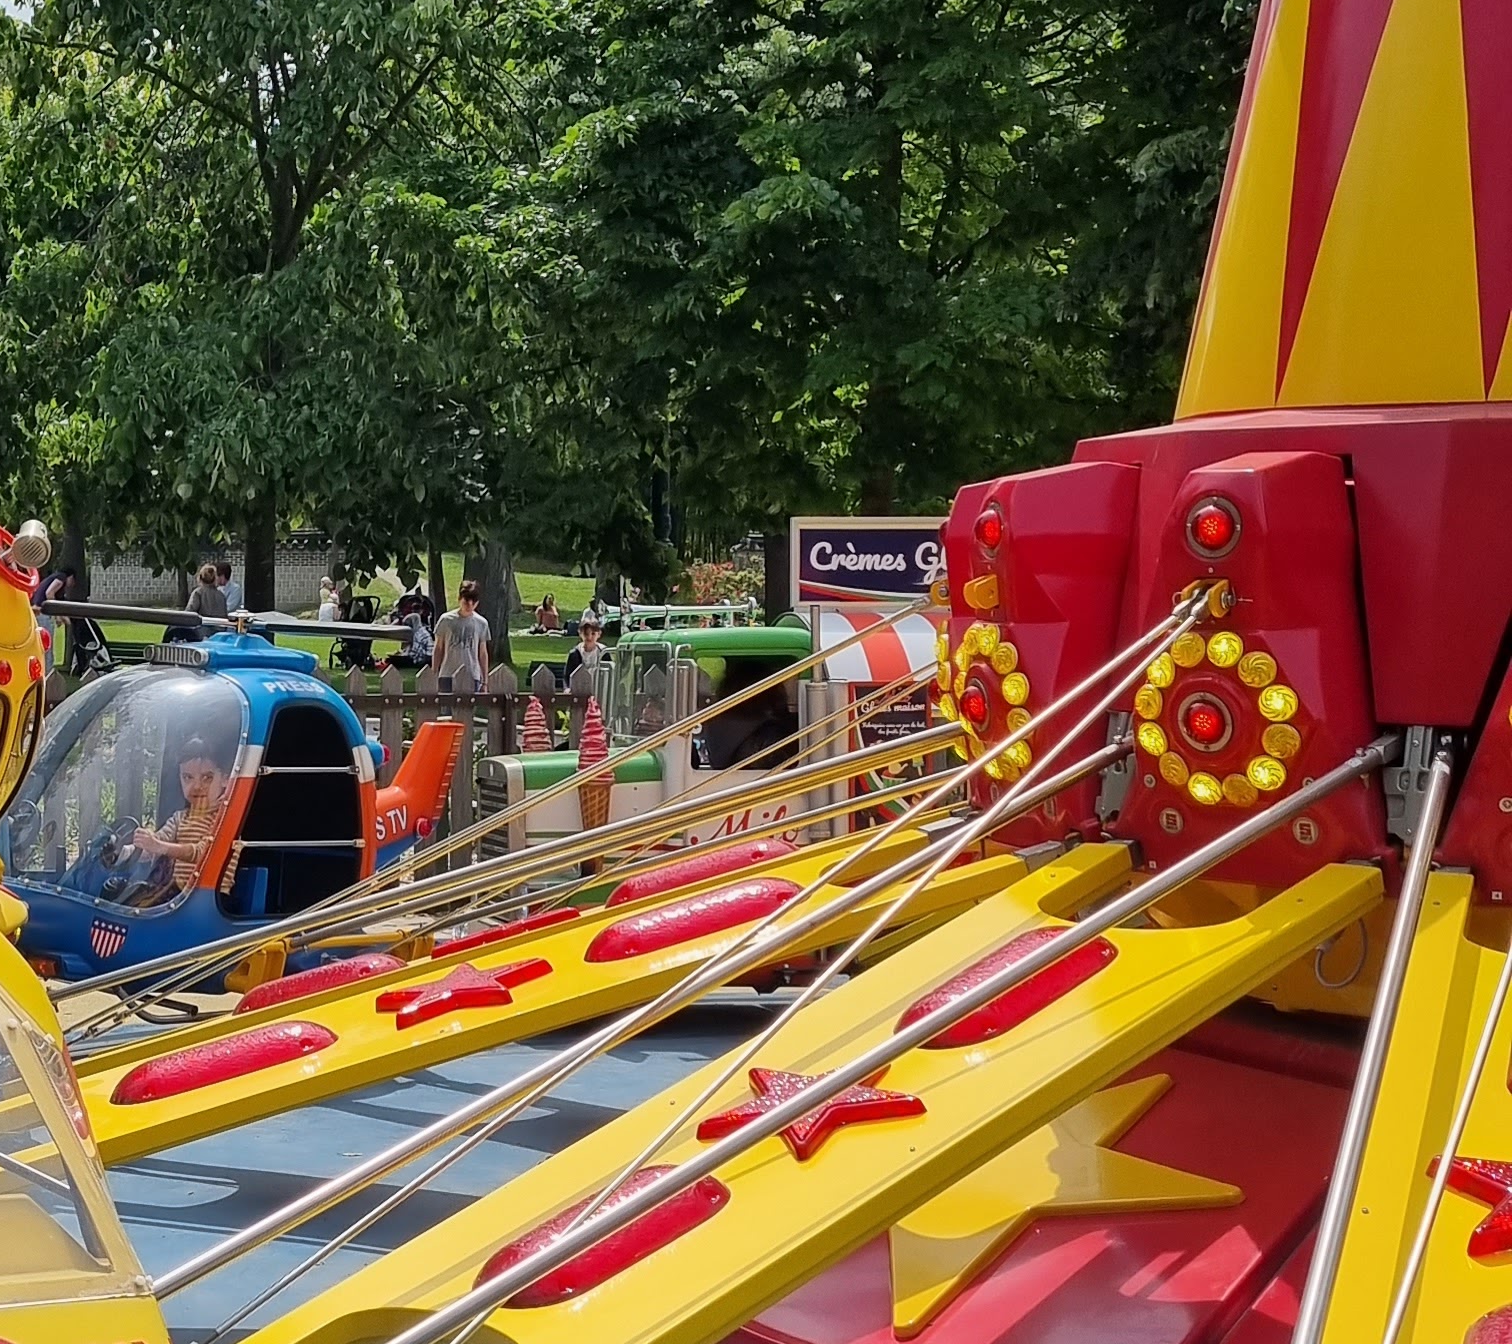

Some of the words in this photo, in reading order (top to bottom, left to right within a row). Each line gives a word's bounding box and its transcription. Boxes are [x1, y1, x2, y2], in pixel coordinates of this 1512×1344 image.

[809, 541, 907, 572] Crèmes
[262, 680, 326, 694] PRESS
[386, 805, 408, 834] TV
